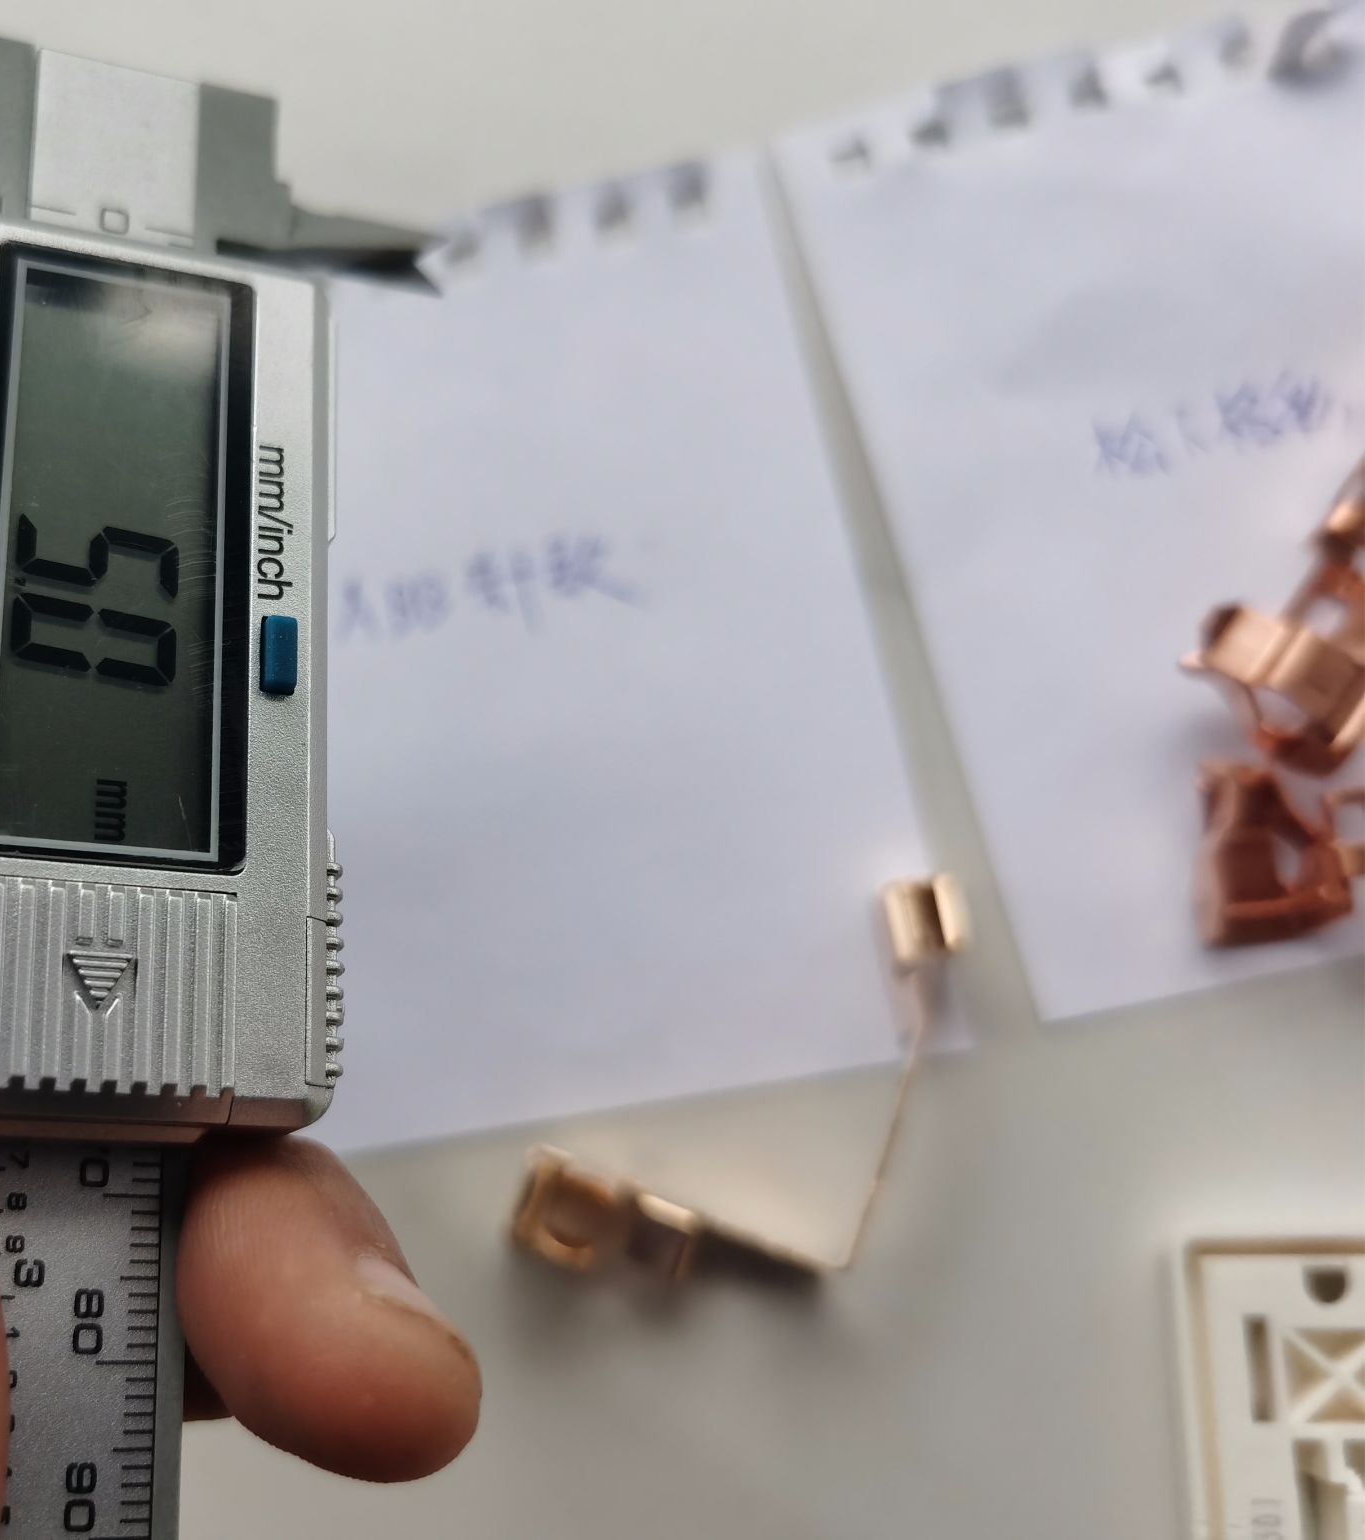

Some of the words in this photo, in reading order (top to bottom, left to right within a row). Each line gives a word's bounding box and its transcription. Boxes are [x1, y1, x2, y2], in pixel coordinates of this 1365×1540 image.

[257, 445, 294, 601] mm/inch
[11, 511, 180, 688] 5.0
[94, 779, 129, 843] mm
[79, 1146, 110, 1188] 0
[6, 1191, 28, 1211] 8
[5, 1234, 26, 1254] 9
[13, 1258, 46, 1288] 3
[72, 1287, 105, 1356] 80
[63, 1461, 98, 1533] 90
